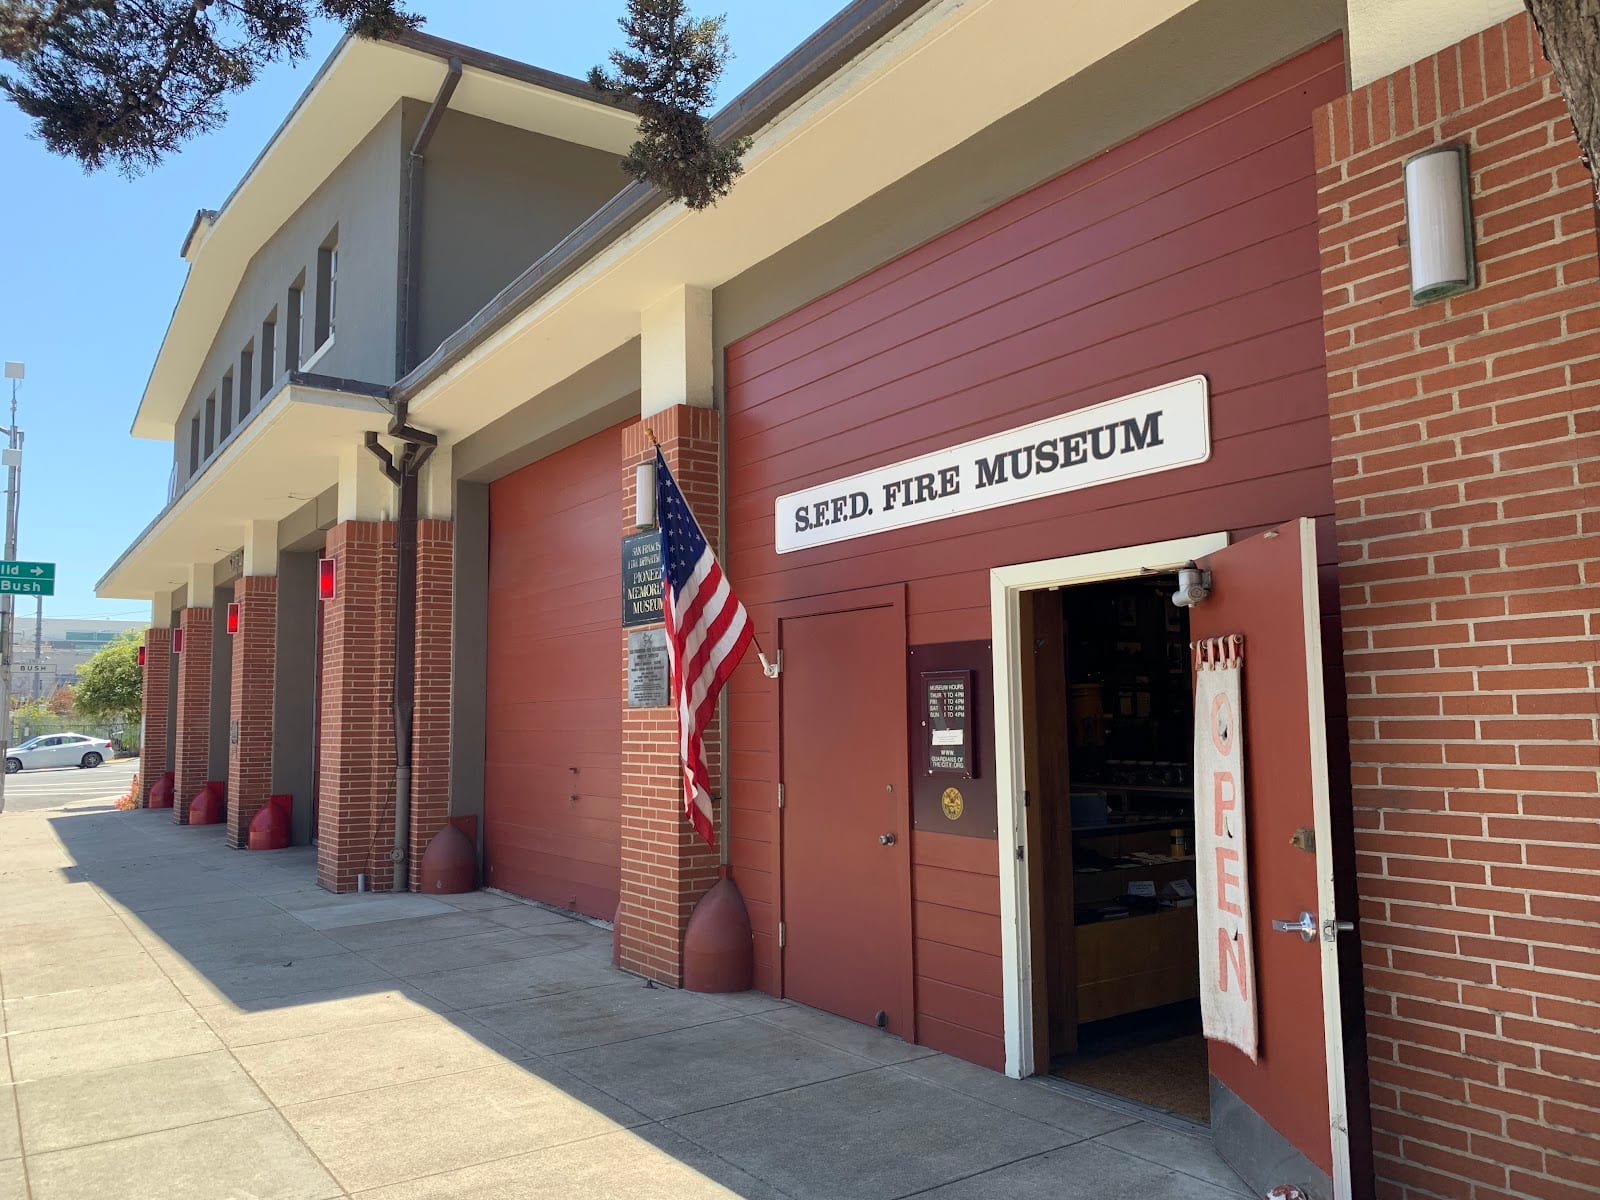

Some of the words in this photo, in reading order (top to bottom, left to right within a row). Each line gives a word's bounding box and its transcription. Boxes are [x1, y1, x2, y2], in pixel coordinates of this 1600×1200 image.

[882, 465, 960, 512] FIRE
[975, 410, 1164, 489] MUSEUM
[1, 580, 41, 592] Bush
[1212, 692, 1247, 1002] OPEN
